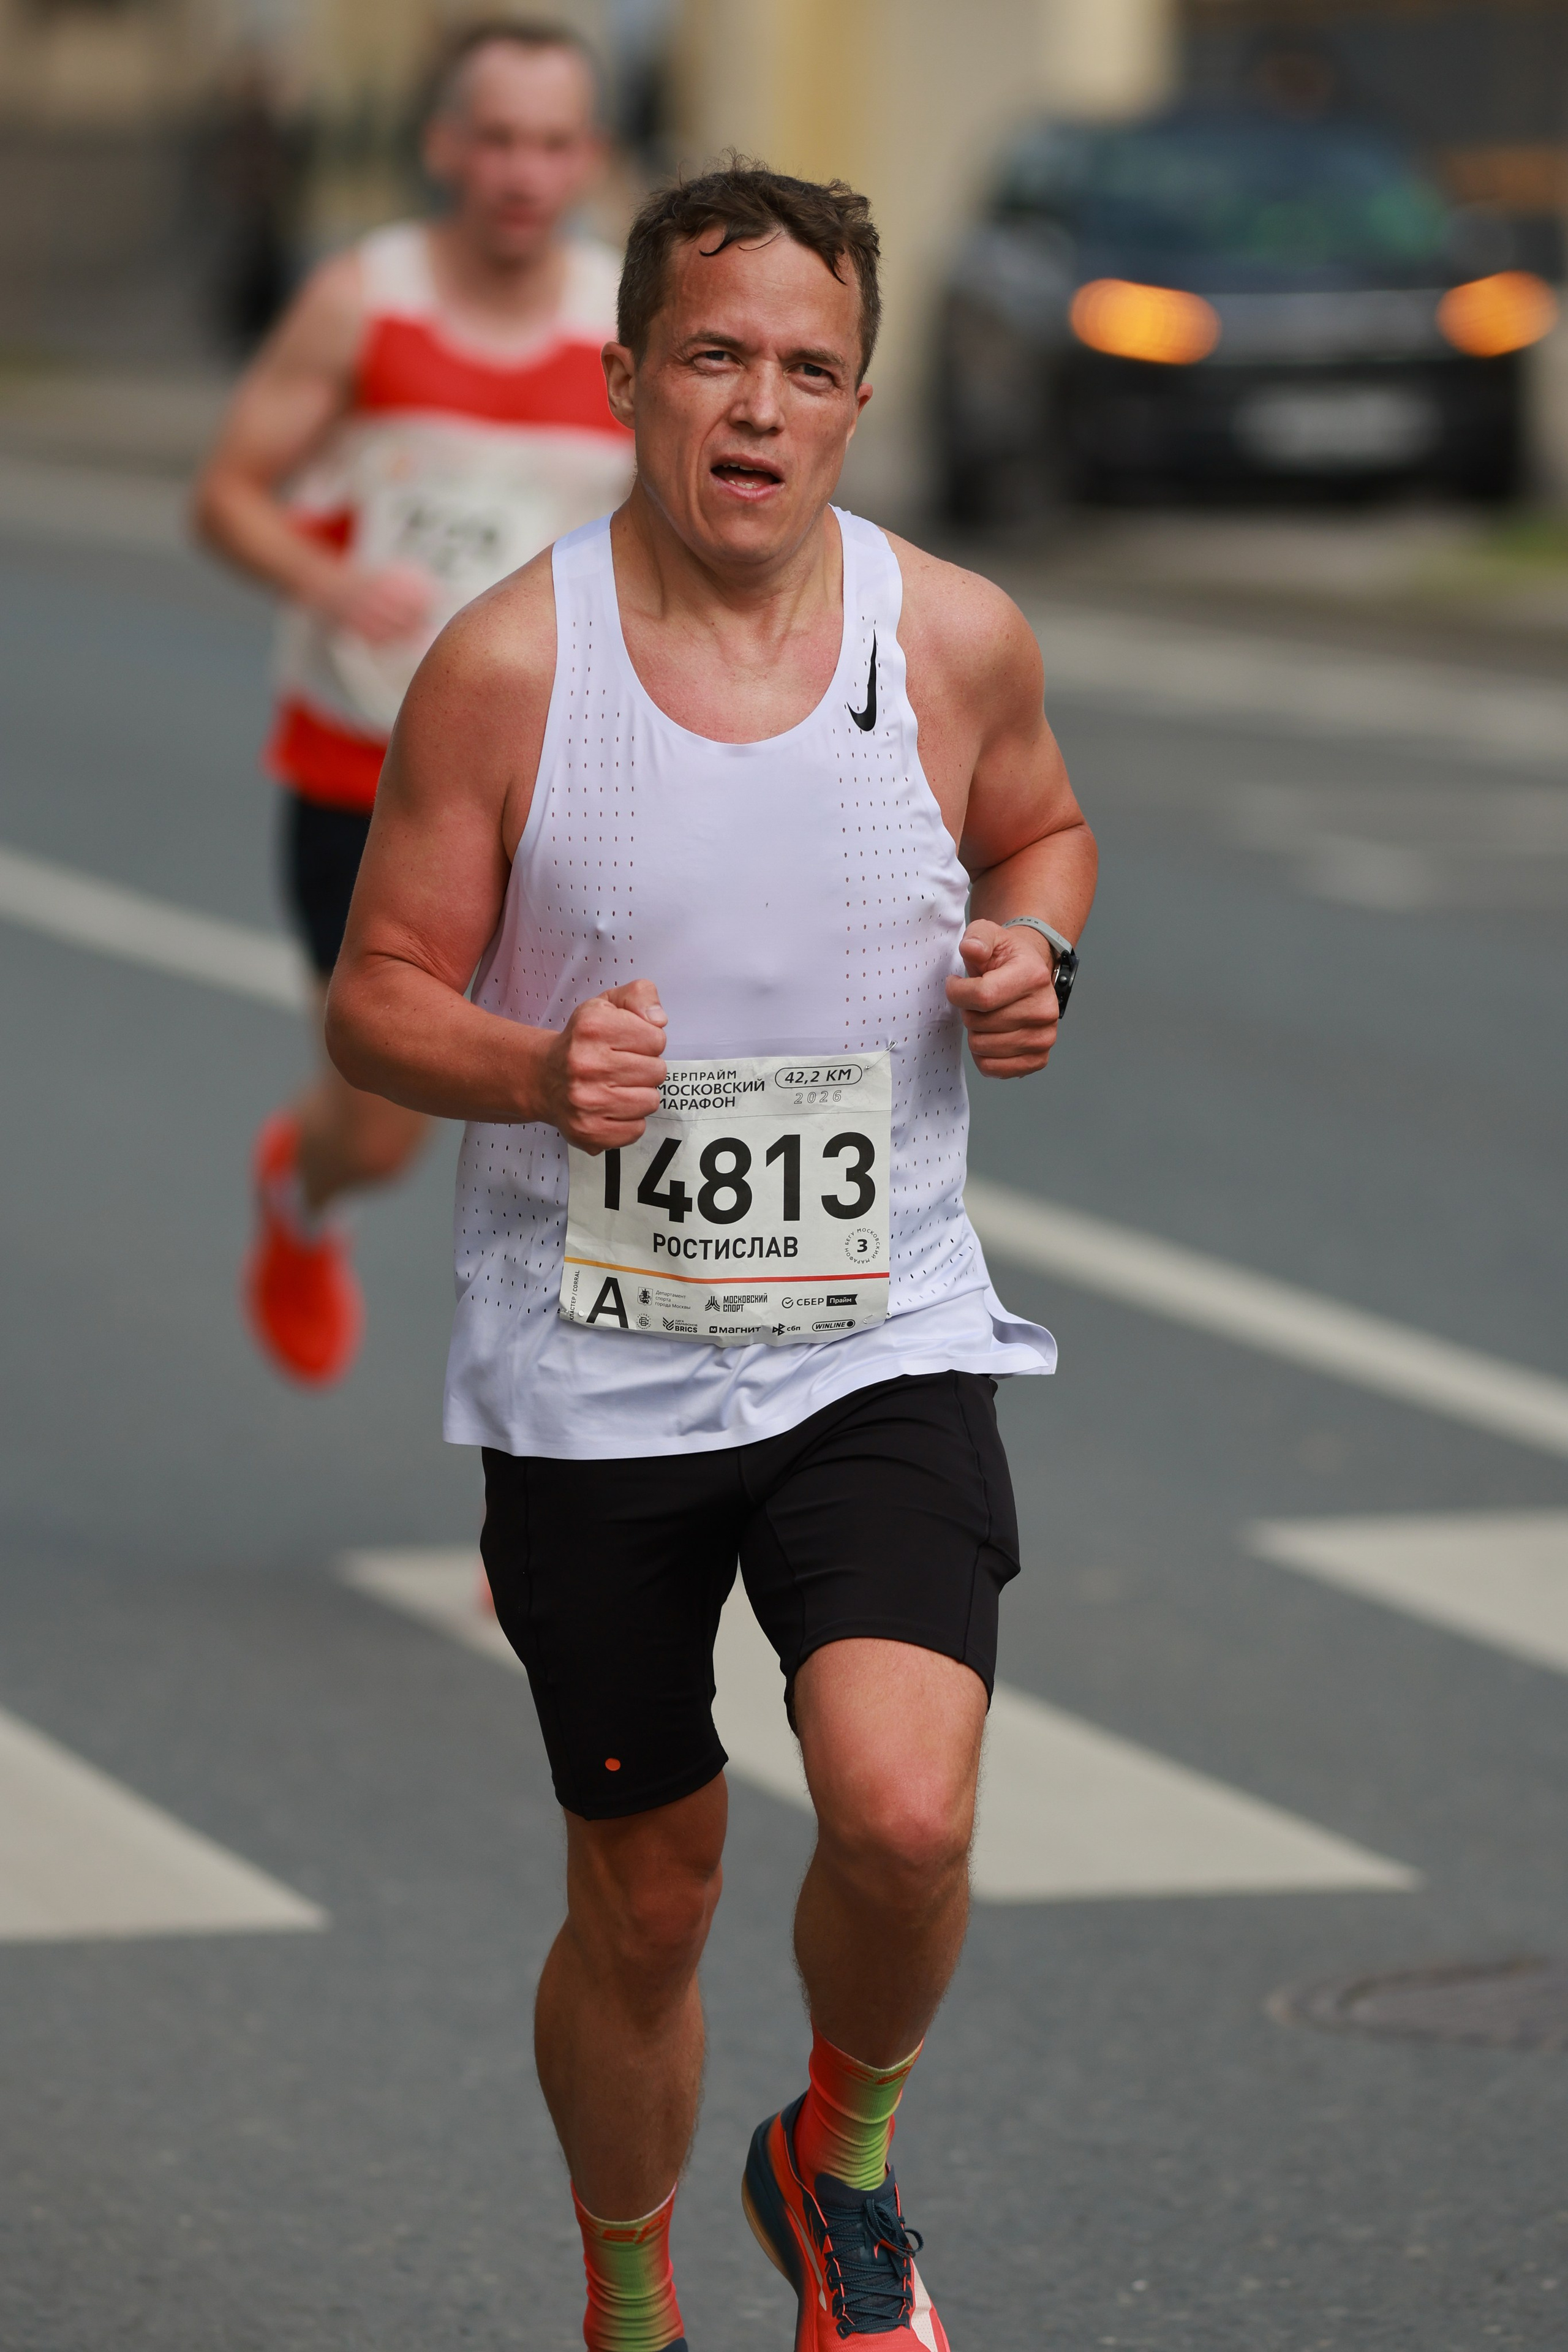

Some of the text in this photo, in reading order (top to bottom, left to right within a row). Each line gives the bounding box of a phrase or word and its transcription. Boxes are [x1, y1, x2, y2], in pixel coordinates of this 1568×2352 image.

[664, 1069, 737, 1082] БЕРПРАЙМ
[784, 1068, 852, 1085] 42,2 КМ
[655, 1078, 765, 1096] МОСКОВСКИЙ
[793, 1090, 842, 1104] 2026
[604, 1131, 876, 1225] 14813
[652, 1232, 799, 1261] РОСТИСЛАВ
[845, 1227, 881, 1264] БЕГУ МОСКОВСКИЙ МАРАФОН
[856, 1238, 868, 1253] 3
[655, 1290, 686, 1299] Департамент
[723, 1292, 768, 1304] МОСКОВСКИЙ
[796, 1296, 853, 1306] СБЕР Прайм
[723, 1304, 744, 1313] СПОРТ
[815, 1321, 846, 1330] WINLINE
